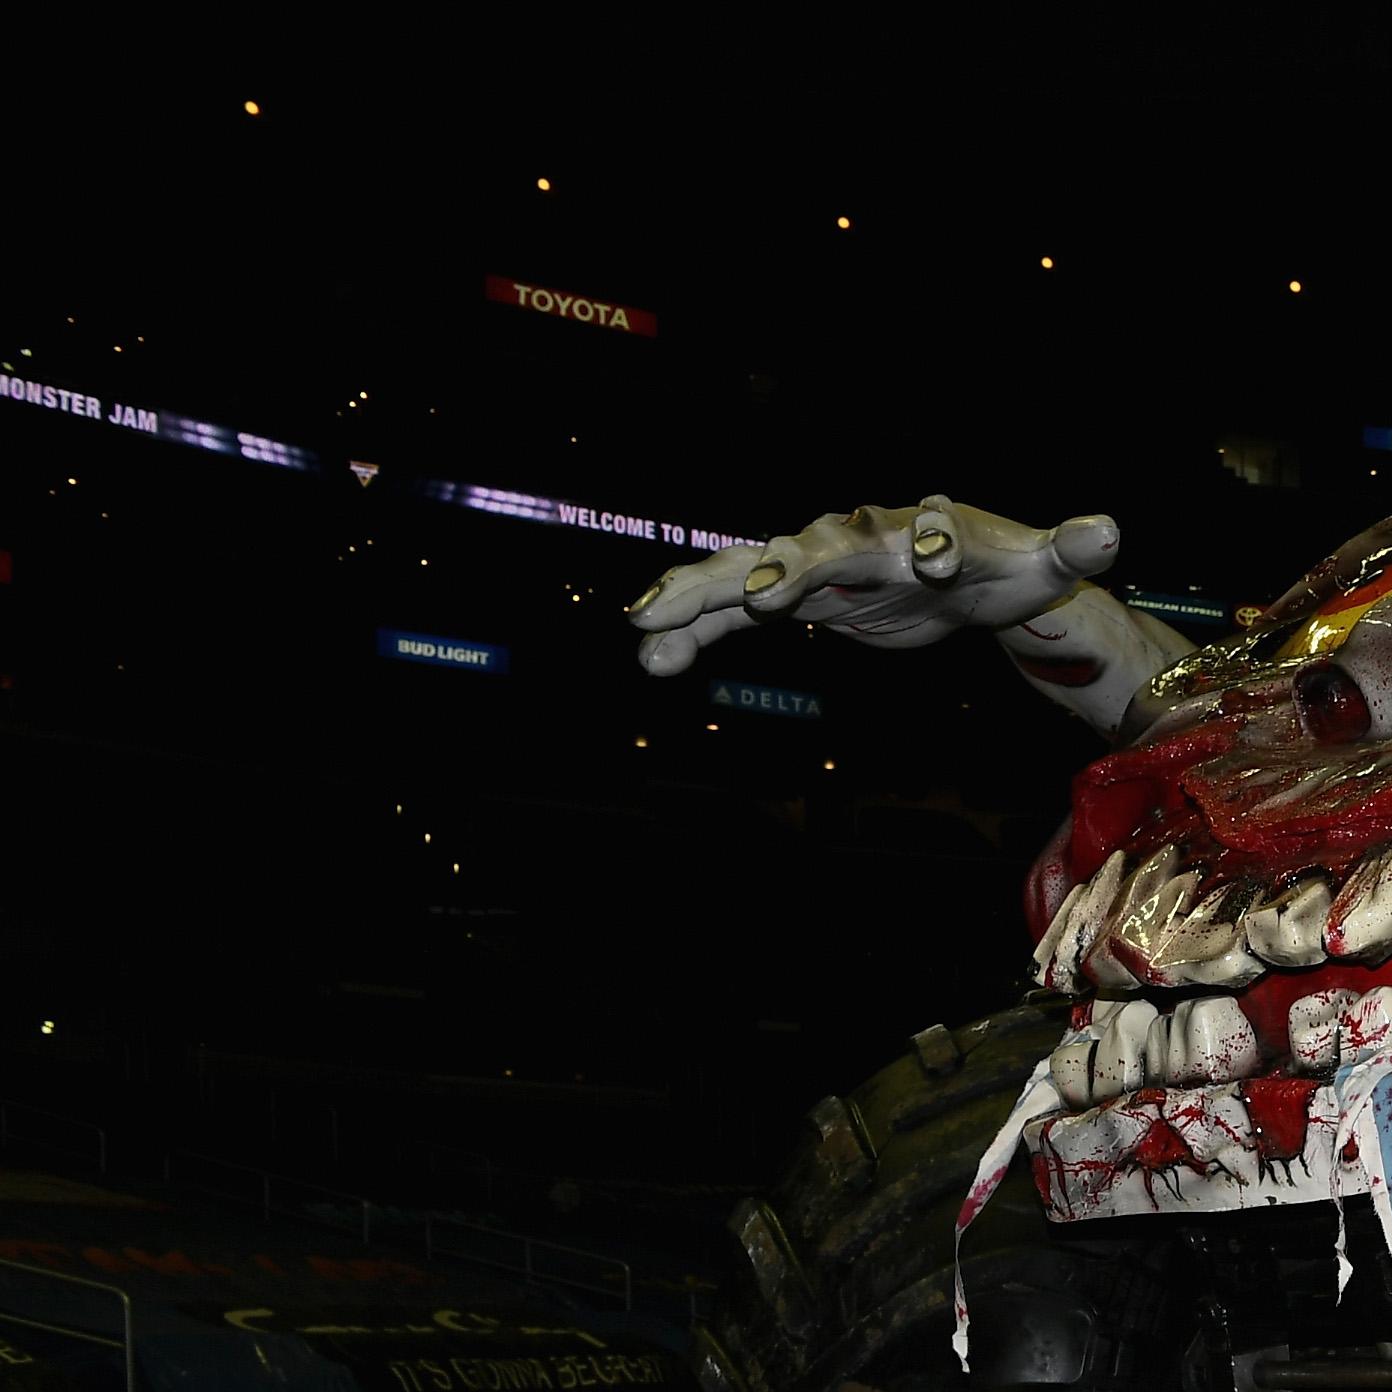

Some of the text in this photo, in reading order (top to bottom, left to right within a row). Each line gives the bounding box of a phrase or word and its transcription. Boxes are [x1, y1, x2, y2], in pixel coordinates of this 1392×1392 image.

[513, 283, 630, 330] TOYOTA
[108, 403, 157, 433] JAM
[558, 503, 657, 540] WELCOME
[660, 523, 685, 545] TO
[397, 639, 490, 665] BUD LIGHT
[741, 688, 821, 716] DELTA
